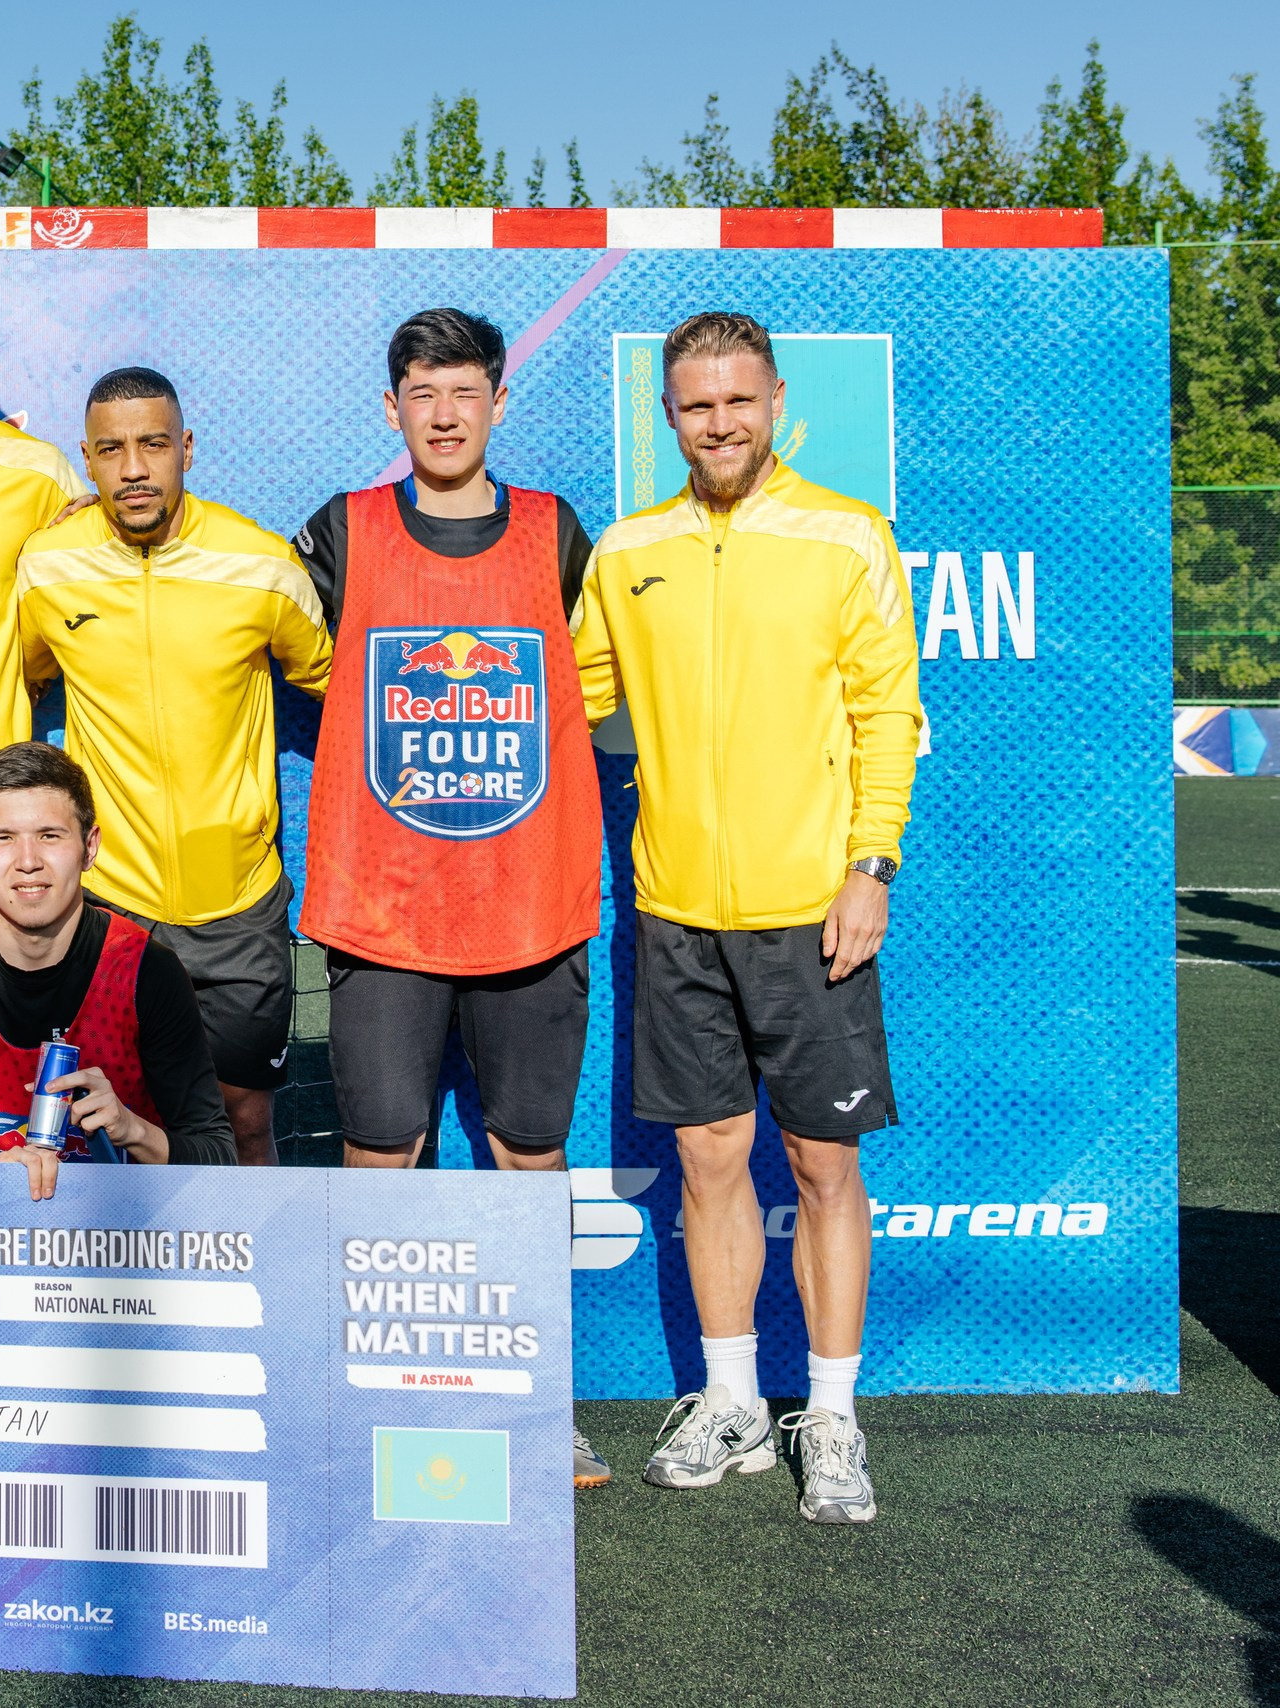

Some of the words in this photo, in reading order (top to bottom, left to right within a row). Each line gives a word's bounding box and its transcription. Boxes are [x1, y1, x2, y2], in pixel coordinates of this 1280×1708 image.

[385, 684, 459, 722] Red
[462, 684, 535, 723] Bull
[402, 730, 520, 767] FOUR
[33, 1229, 176, 1270] BOARDING
[182, 1231, 254, 1272] PASS
[345, 1239, 477, 1274] SCORE
[34, 1283, 72, 1292] REASON
[345, 1280, 466, 1315] WHEN
[478, 1283, 516, 1316] IT
[34, 1296, 108, 1314] NATIONAL
[113, 1298, 157, 1316] FINAL
[346, 1321, 539, 1358] MATTERS
[402, 1374, 416, 1385] IN
[420, 1374, 473, 1386] ASTANA
[4, 1599, 114, 1624] zakon.kz
[164, 1612, 268, 1634] BES.media
